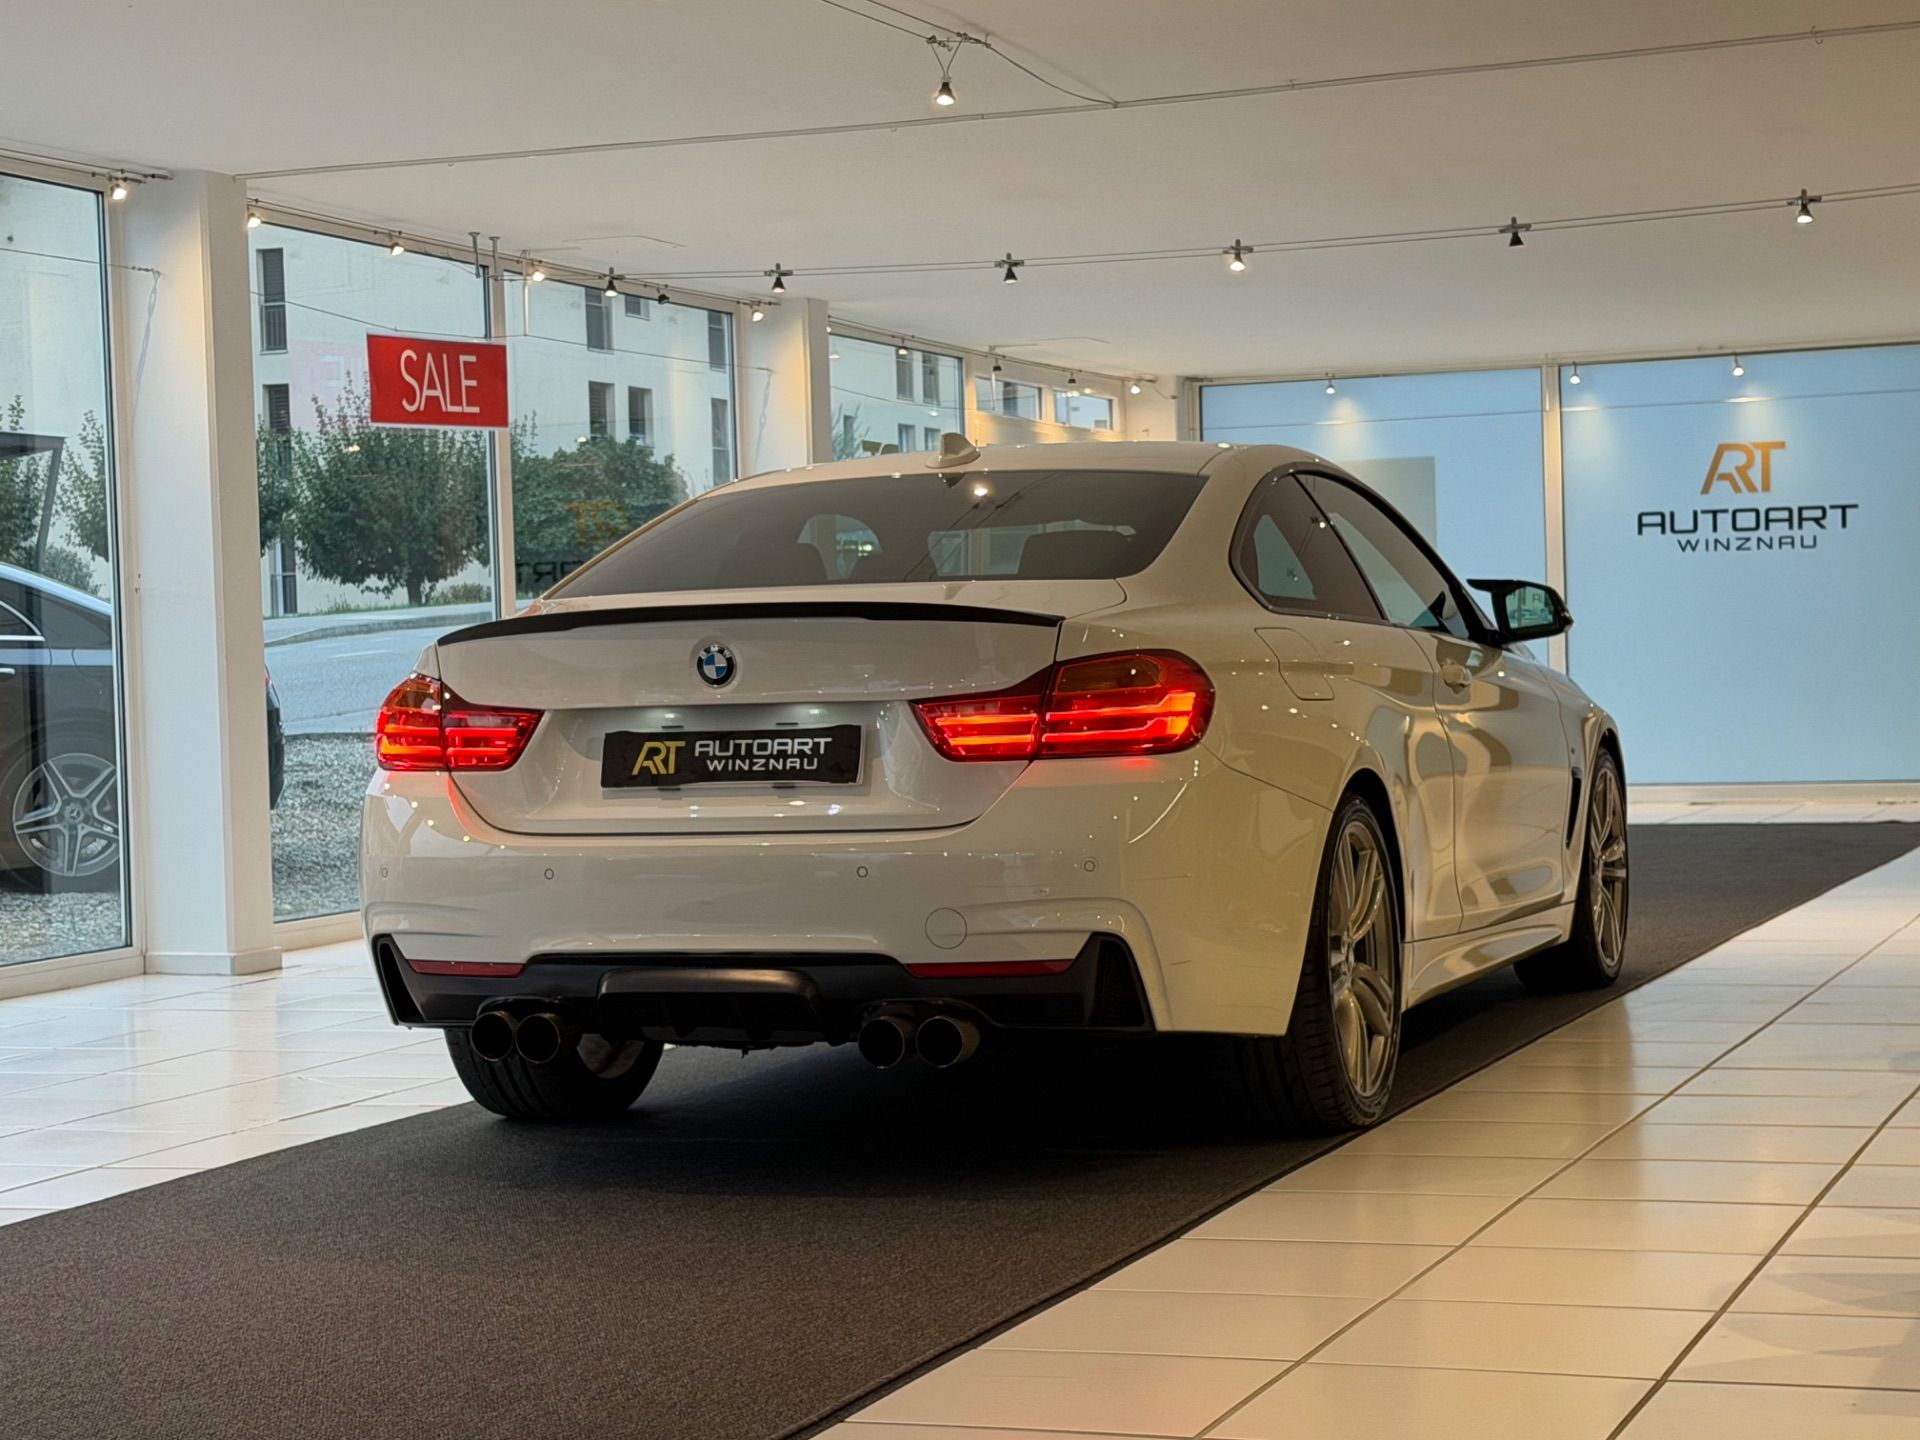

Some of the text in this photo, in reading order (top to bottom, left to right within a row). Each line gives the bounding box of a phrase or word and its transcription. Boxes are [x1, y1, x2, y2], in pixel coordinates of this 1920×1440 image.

[400, 349, 479, 413] SALE
[1701, 440, 1786, 495] ART
[1637, 504, 1859, 536] AUTOART
[1677, 535, 1817, 552] WINZNAU
[631, 740, 686, 776] ART
[694, 737, 832, 757] AUTOART
[706, 758, 818, 771] WINZNAU
